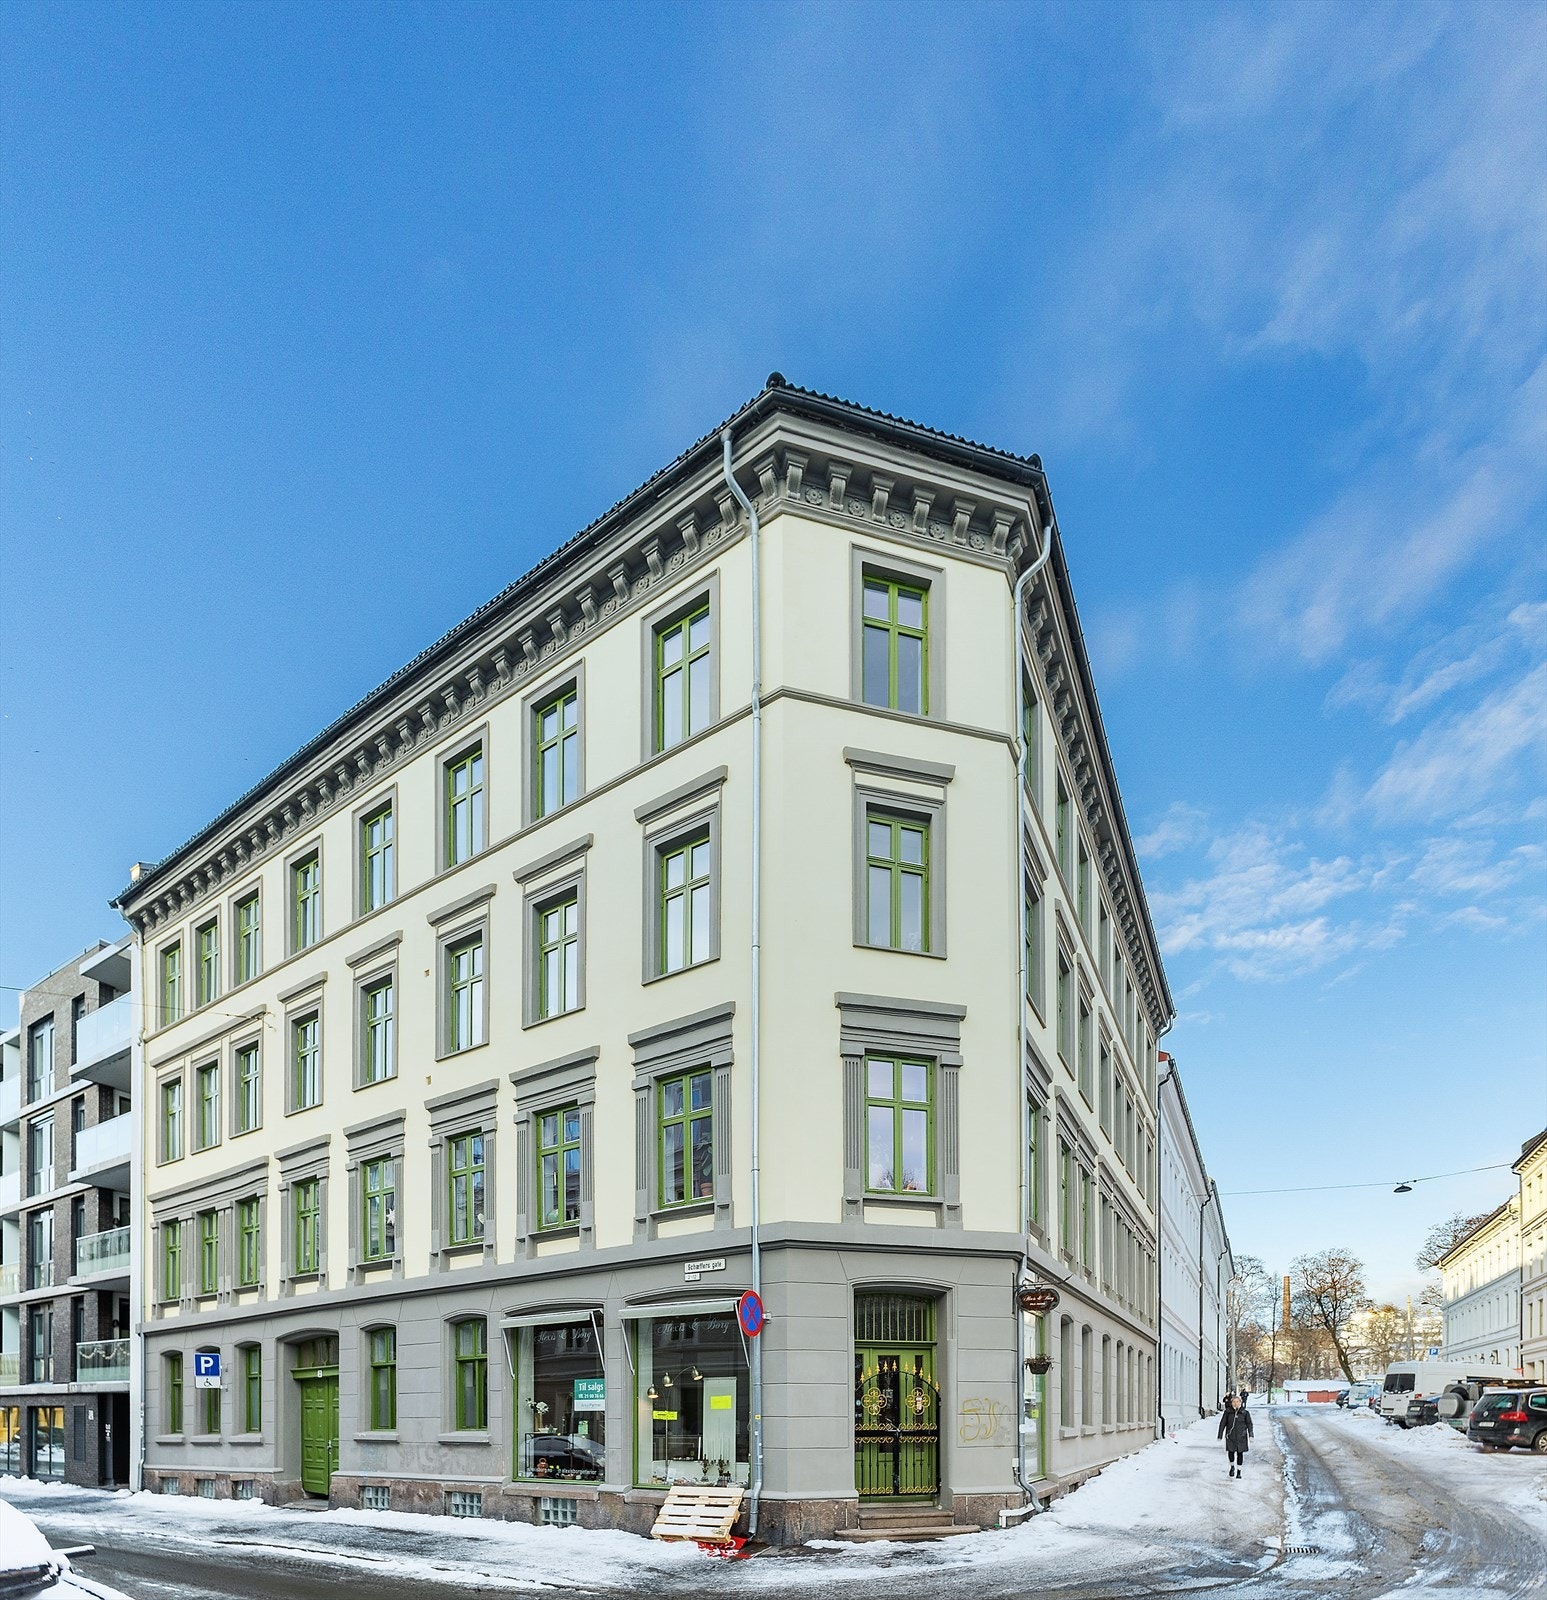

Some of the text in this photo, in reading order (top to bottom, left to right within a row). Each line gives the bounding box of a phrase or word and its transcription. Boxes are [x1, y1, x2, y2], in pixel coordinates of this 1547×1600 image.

[712, 1260, 722, 1270] gate
[689, 1317, 700, 1331] &
[559, 1327, 567, 1340] &
[200, 1356, 214, 1374] P
[578, 1381, 604, 1393] Til salgs
